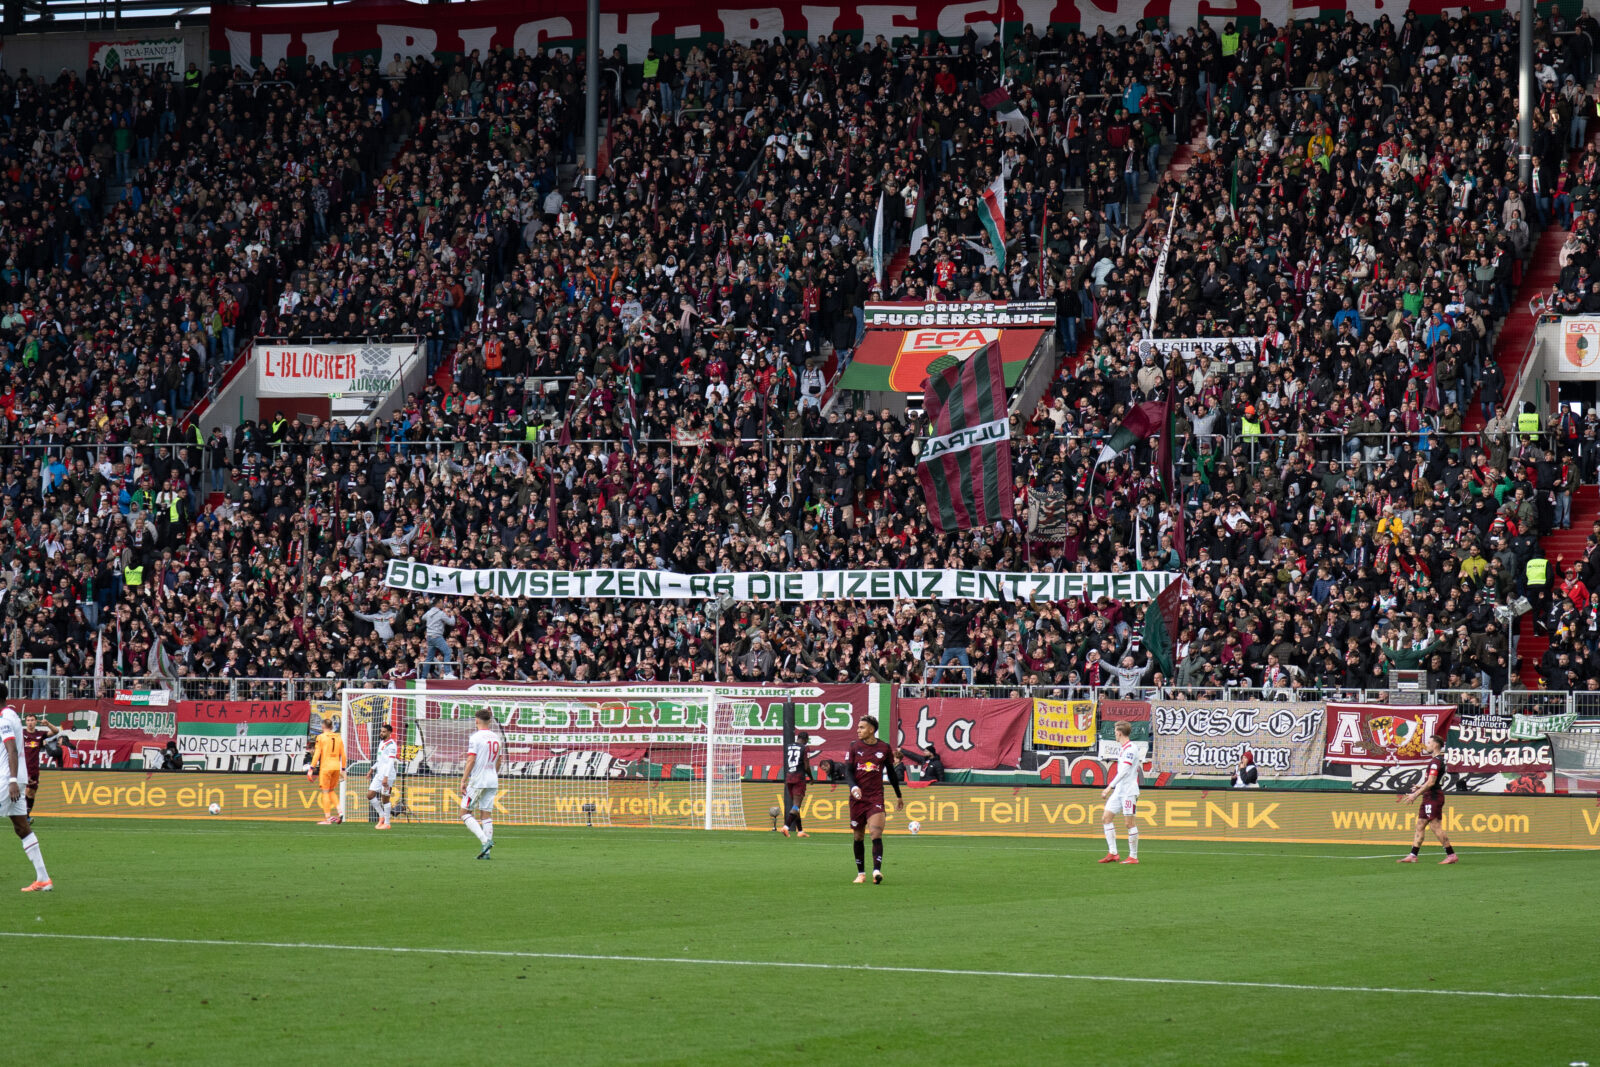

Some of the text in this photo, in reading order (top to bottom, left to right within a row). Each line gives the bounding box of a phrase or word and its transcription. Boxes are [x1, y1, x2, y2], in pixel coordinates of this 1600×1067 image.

[923, 302, 995, 313] GRUPPE
[872, 312, 1044, 326] FUGGERSTADT
[1569, 323, 1597, 333] FCA
[913, 329, 988, 348] FCA
[265, 351, 356, 380] L-BLOCKER
[388, 561, 462, 594] 50+1
[474, 567, 662, 597] UMSETZEN
[747, 573, 804, 601] DIE
[817, 570, 944, 599] LIZENZ
[195, 703, 228, 718] FCA
[249, 703, 294, 718] FANS
[730, 701, 854, 731] RAUS
[1037, 701, 1068, 715] Frei
[108, 710, 176, 730] CONCORDIA
[532, 733, 560, 743] DEM
[567, 734, 635, 743] FUSSBALL
[656, 735, 685, 743] DEM
[716, 735, 783, 745] AUGSBUR
[1037, 729, 1088, 744] Bayern
[1327, 711, 1367, 756] A
[1458, 725, 1513, 744] BLU
[331, 737, 336, 753] 1
[487, 740, 500, 763] 19
[787, 749, 801, 769] 23
[1446, 745, 1553, 768] BRIGADE
[60, 780, 168, 808] Werde
[176, 782, 225, 808] ein
[234, 783, 288, 810] Teil
[555, 791, 732, 817] www.renk.com
[776, 793, 1281, 830] Were ein Teil von RENK
[1331, 806, 1530, 833] www.rk.com
